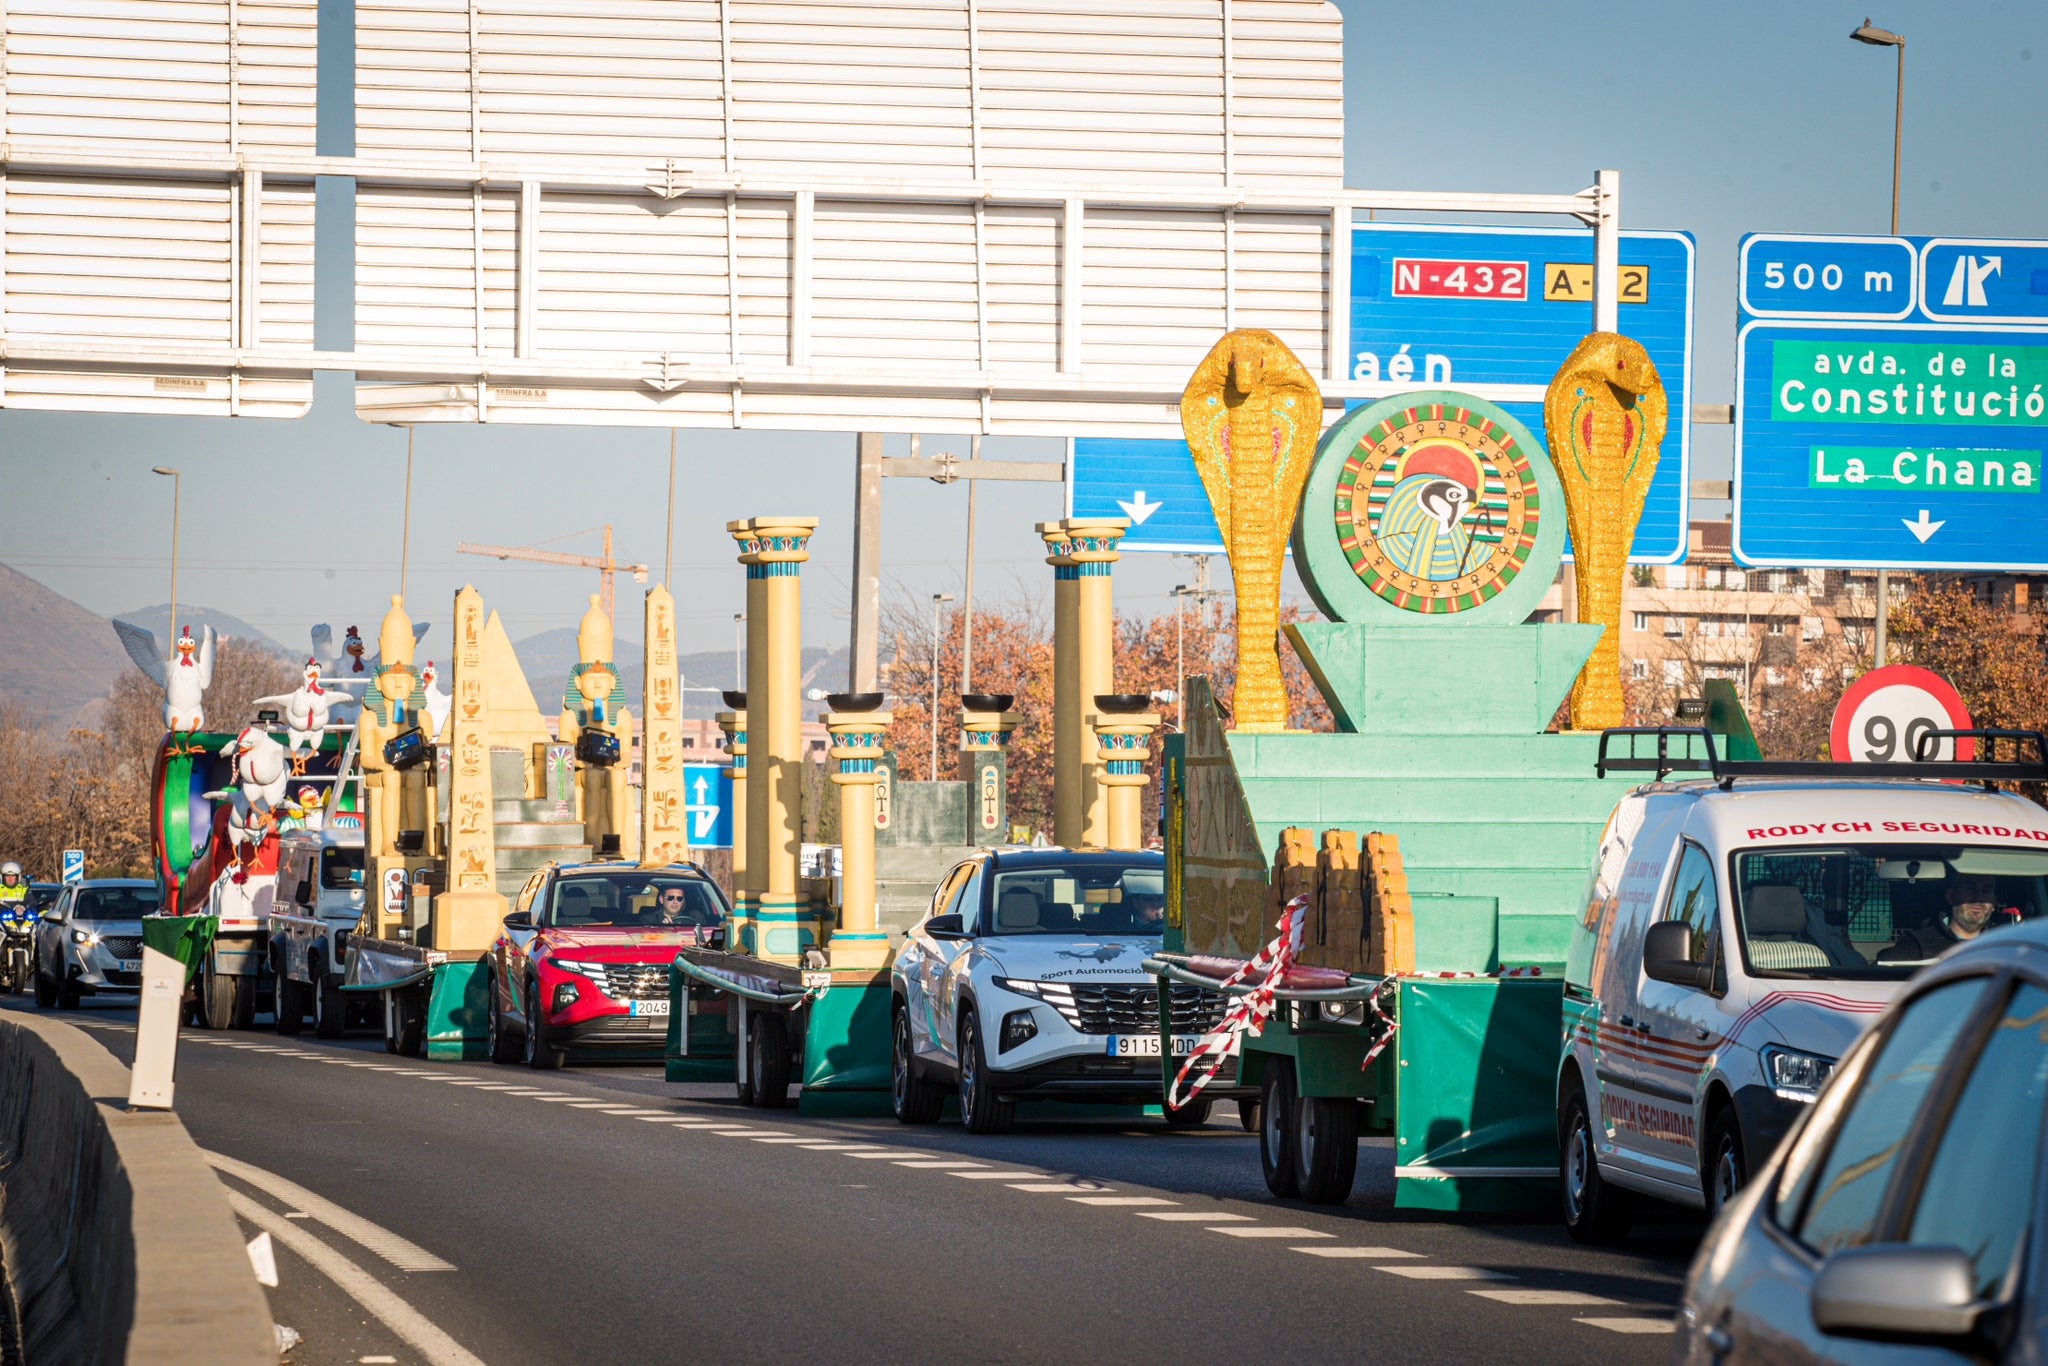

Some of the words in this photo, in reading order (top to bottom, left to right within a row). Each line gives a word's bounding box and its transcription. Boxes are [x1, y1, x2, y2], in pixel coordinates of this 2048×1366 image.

[1398, 264, 1523, 294] N-432
[1550, 269, 1643, 297] A-2
[1765, 262, 1843, 291] 500
[1864, 270, 1893, 292] m
[1353, 344, 1452, 382] aén
[1814, 350, 1906, 375] avda.
[1928, 352, 1966, 376] de
[1989, 353, 2016, 378] la
[496, 388, 532, 397] SEDINFRA
[1780, 379, 2045, 418] Constitució
[1816, 450, 1865, 483] La
[1893, 452, 2033, 487] Chana
[1863, 715, 1941, 762] 90
[1747, 822, 1873, 840] RODYCH
[1882, 821, 2048, 841] SEGURIDAD
[1041, 968, 1073, 980] Sport
[638, 1003, 668, 1014] 2049
[1120, 1038, 1159, 1054] 9115
[1638, 1102, 1696, 1148] SEGURIDAD
